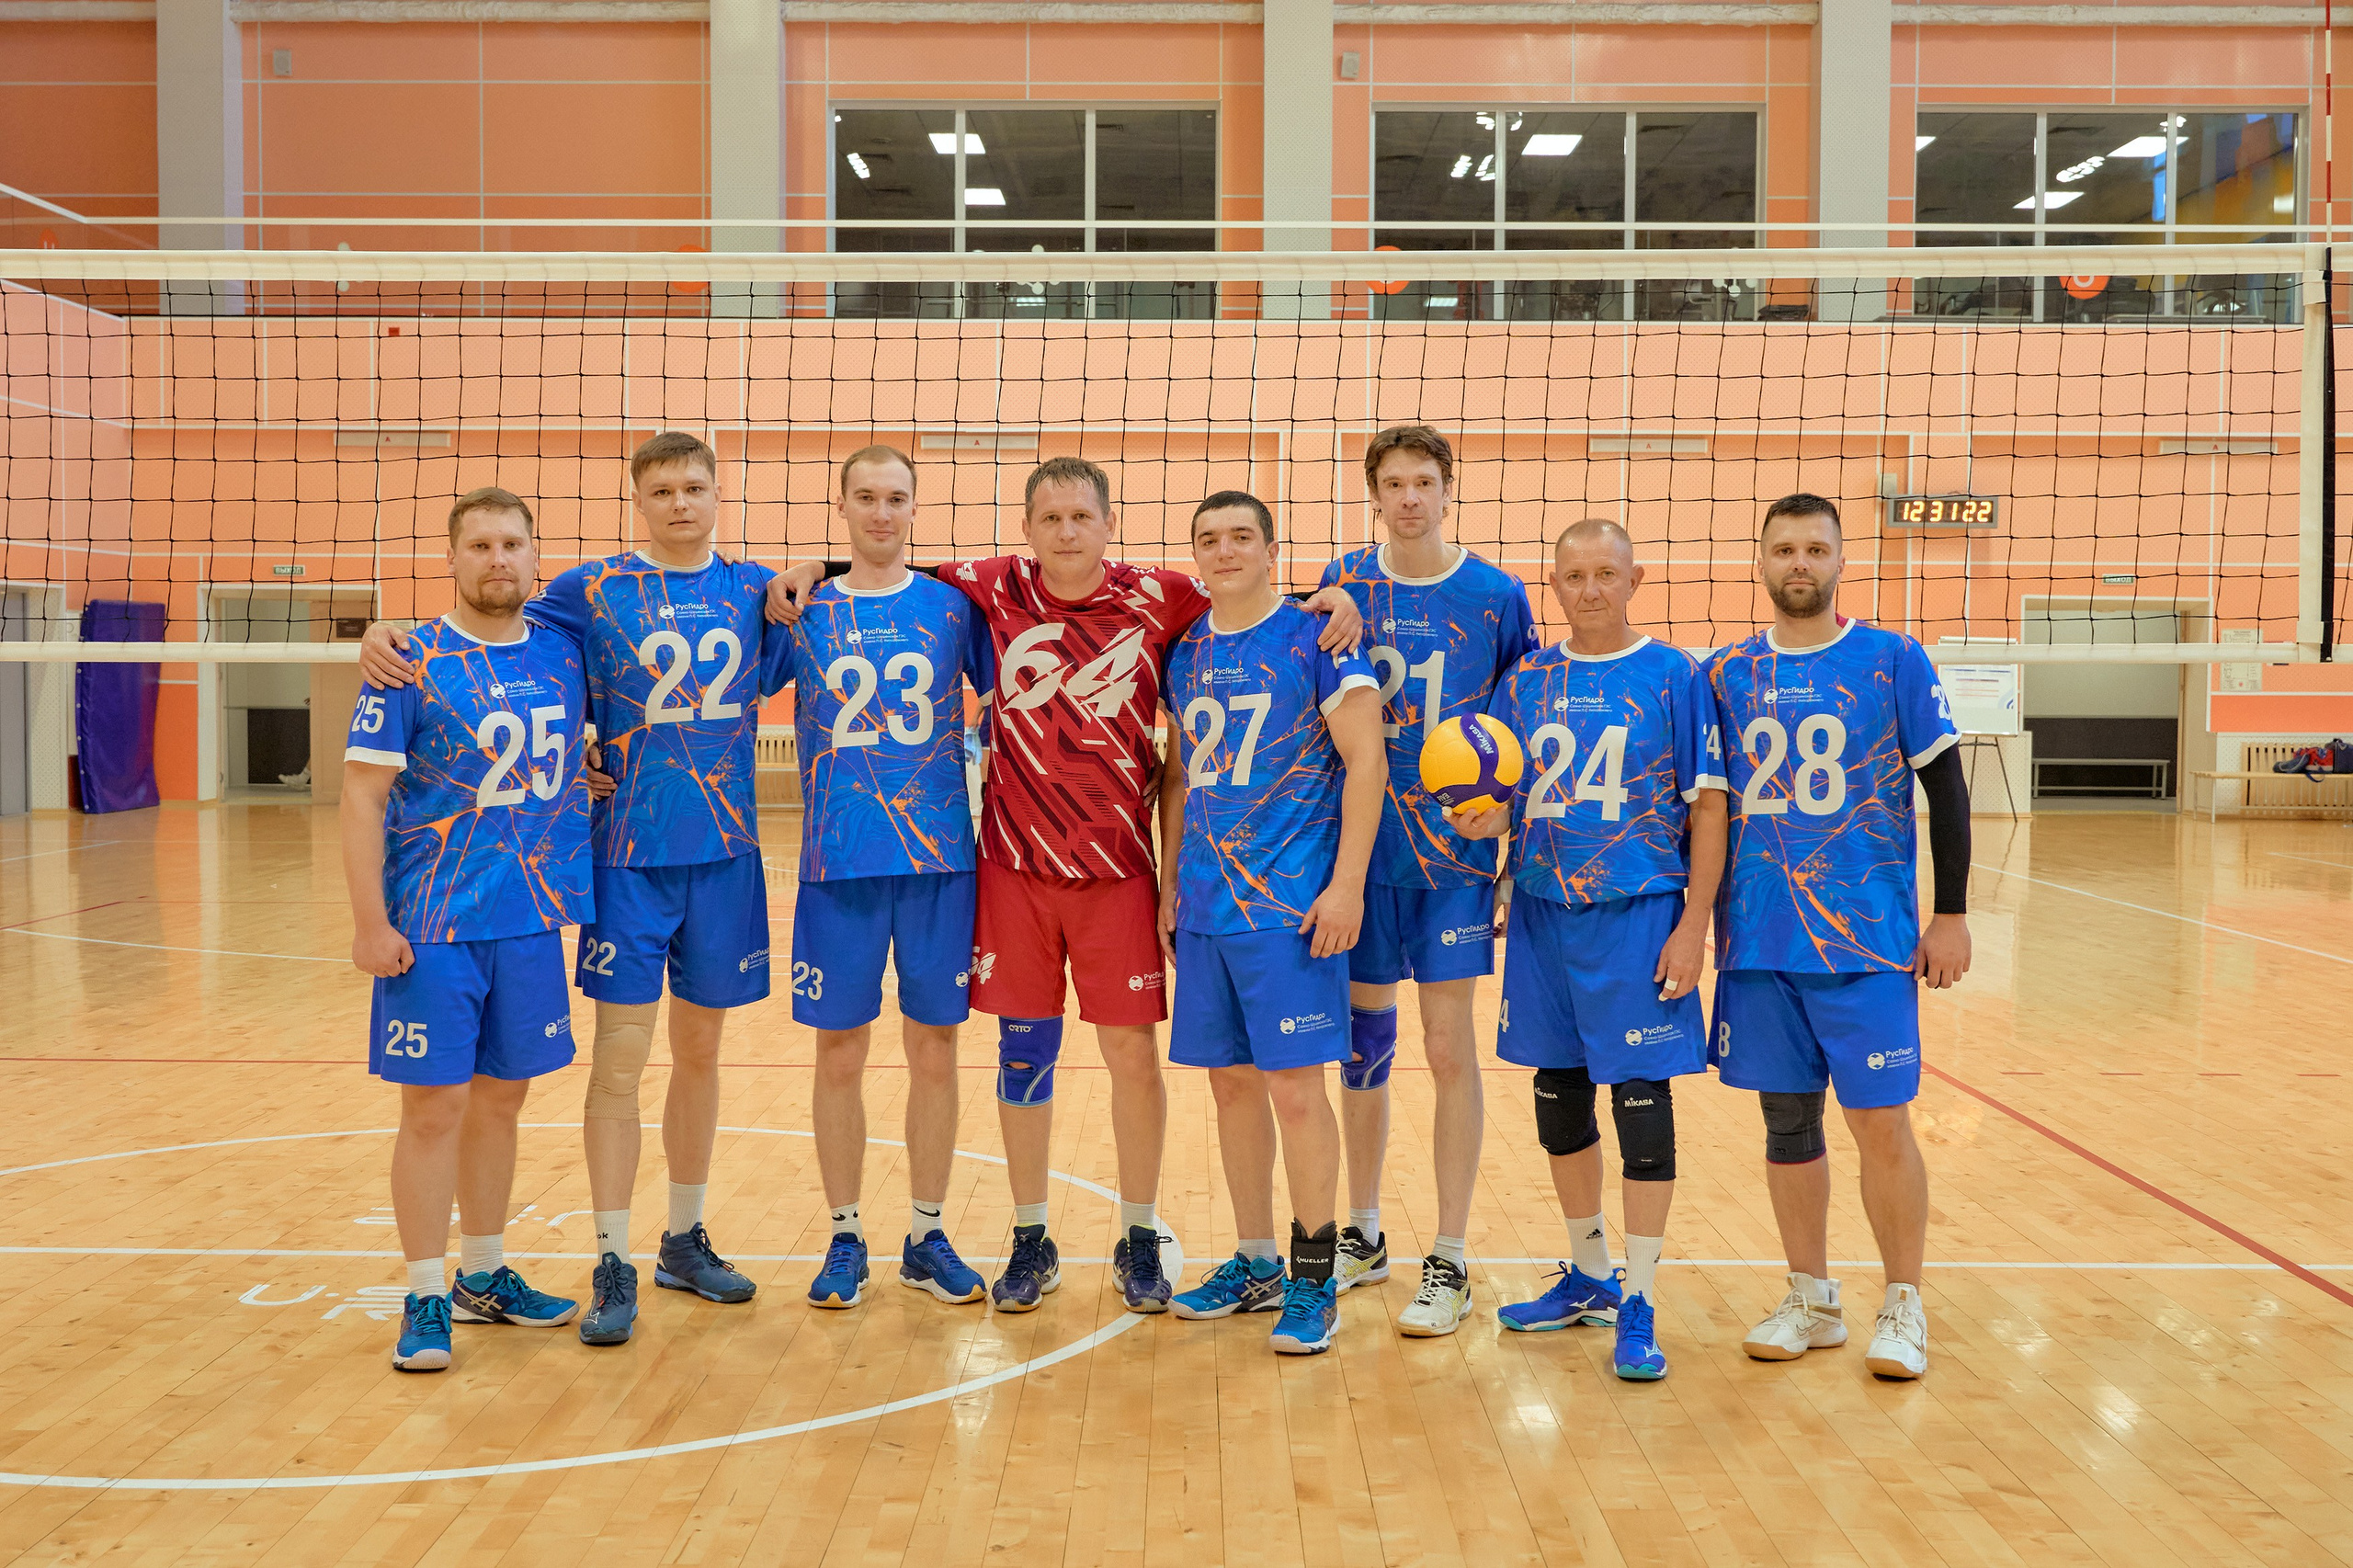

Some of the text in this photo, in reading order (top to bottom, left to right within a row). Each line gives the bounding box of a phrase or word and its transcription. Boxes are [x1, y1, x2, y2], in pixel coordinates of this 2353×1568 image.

[351, 695, 386, 733] 25
[638, 627, 743, 725] 22
[825, 652, 935, 749] 23
[999, 622, 1146, 719] 64
[1368, 645, 1446, 742] 21
[475, 704, 566, 808] 25
[1182, 692, 1272, 790] 27
[1525, 721, 1629, 822] 24
[1741, 713, 1847, 816] 28
[582, 937, 617, 976] 22
[790, 960, 824, 1001] 23
[385, 1019, 428, 1059] 25
